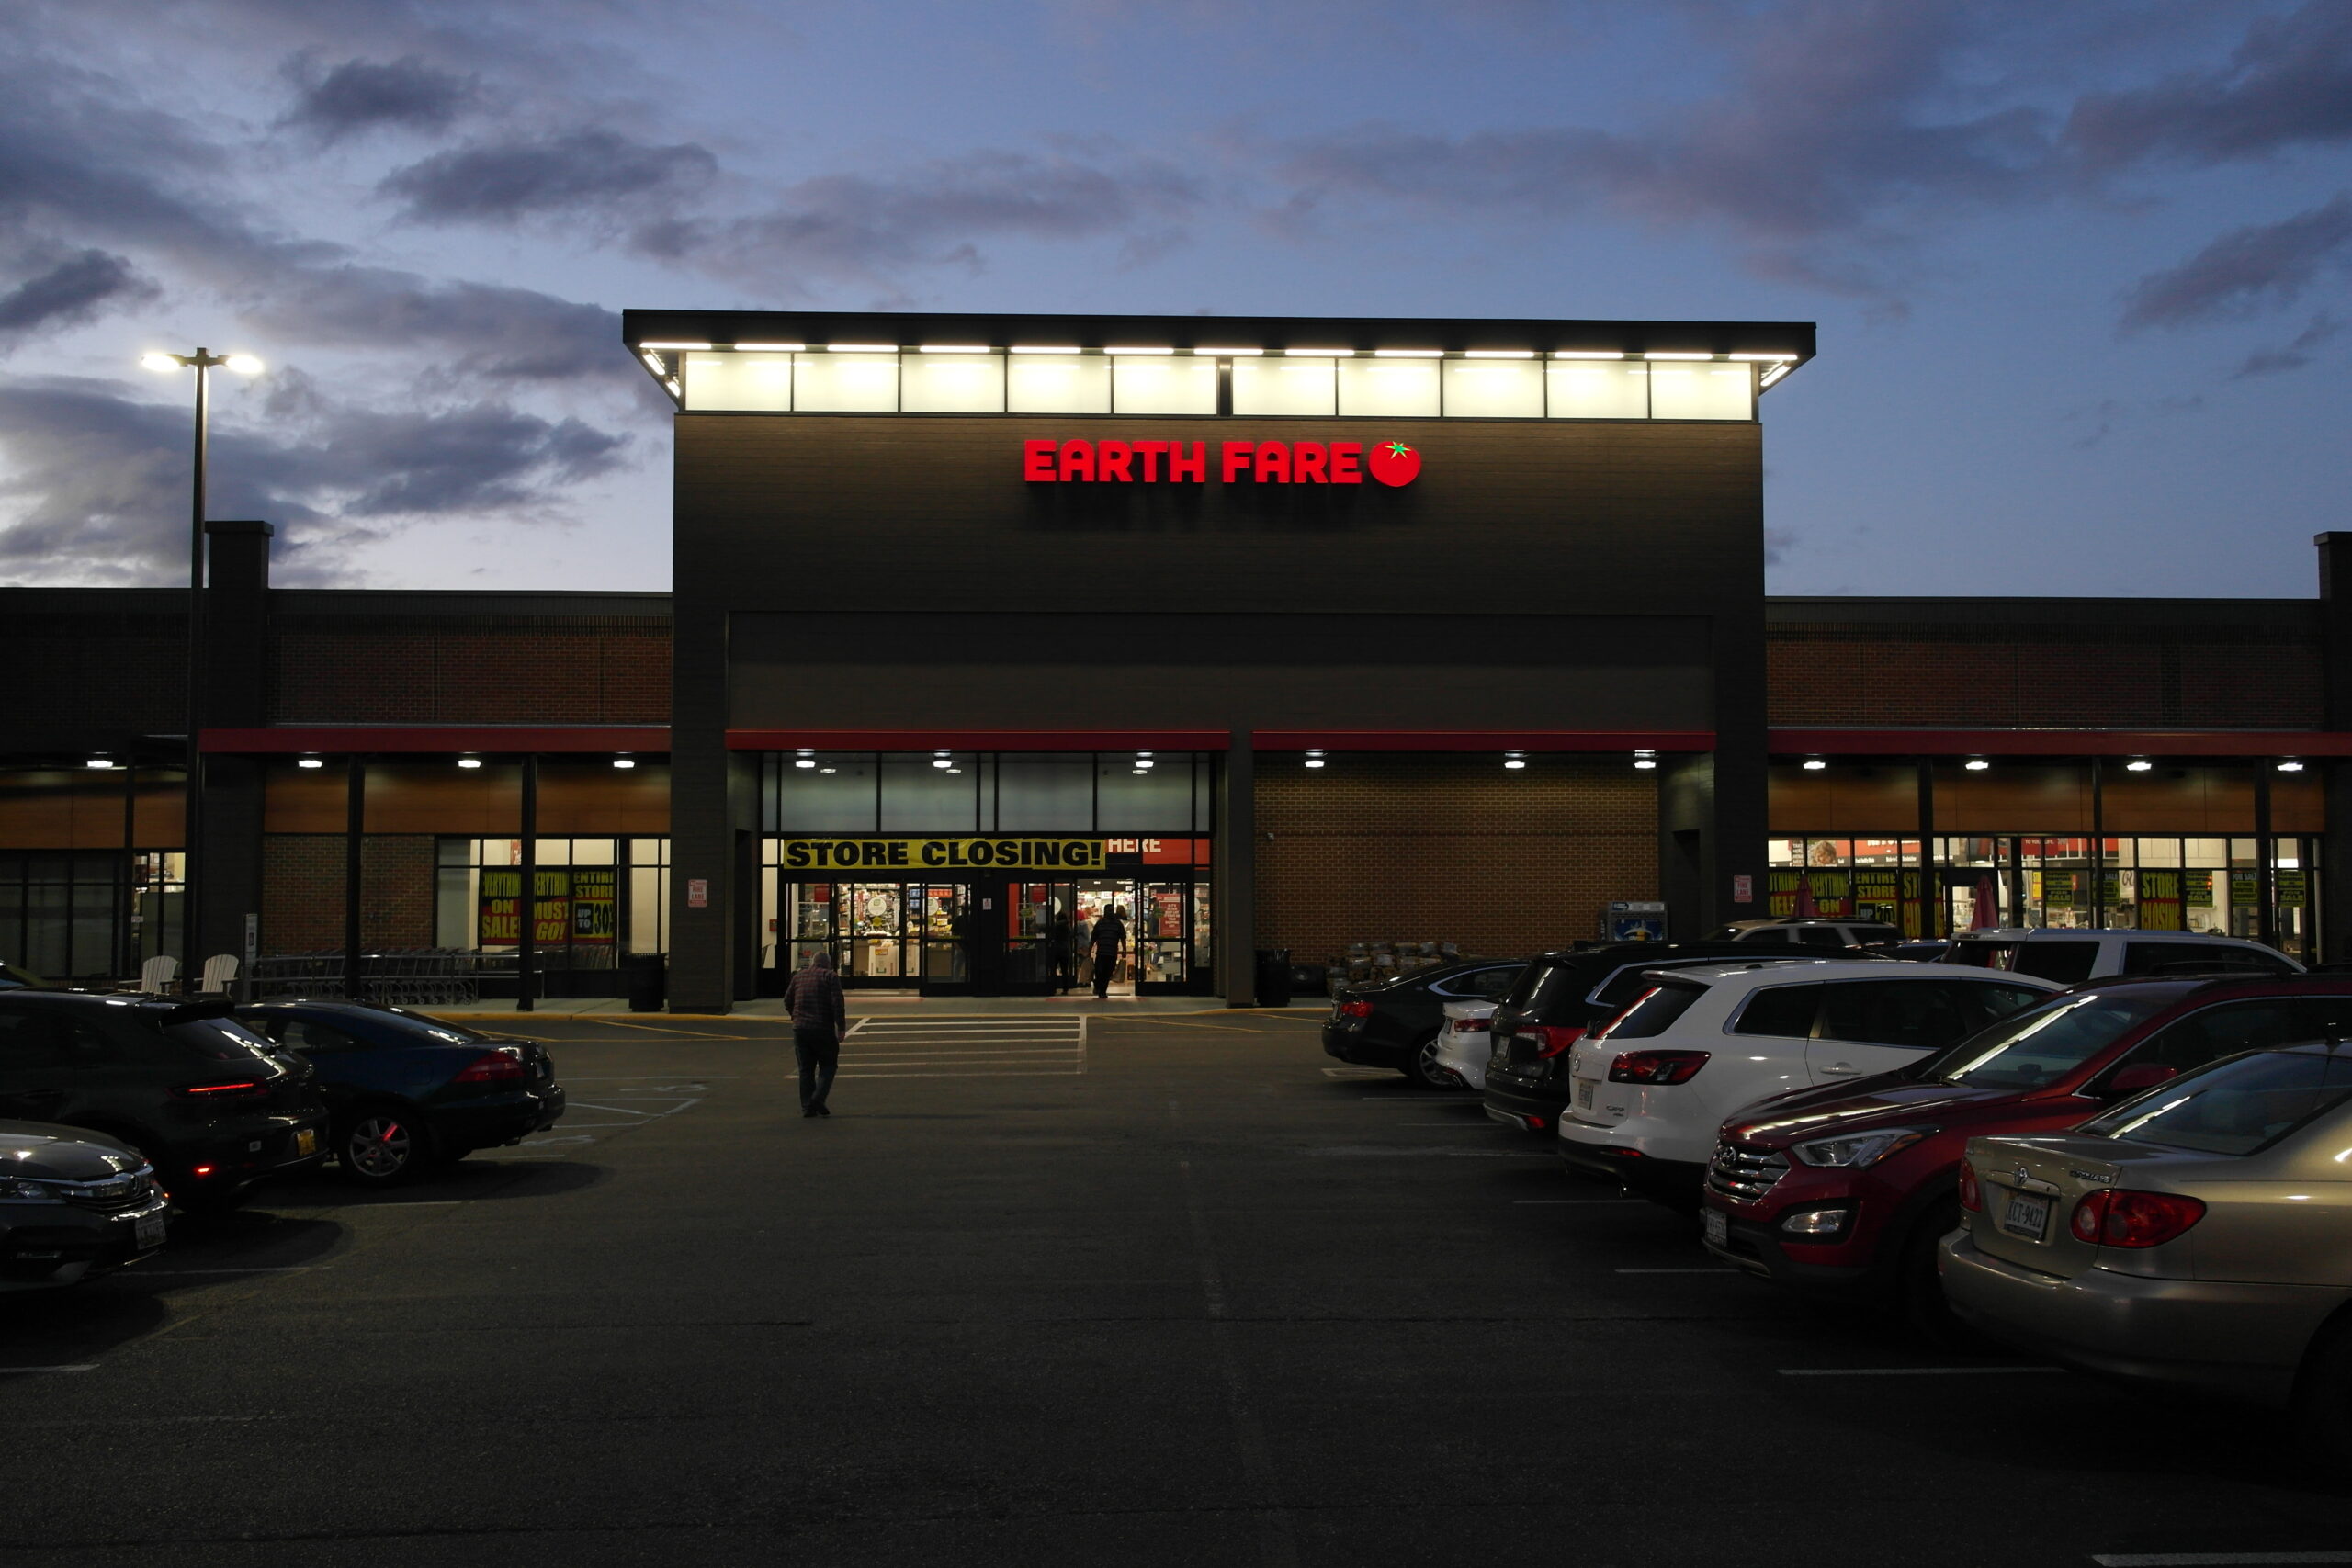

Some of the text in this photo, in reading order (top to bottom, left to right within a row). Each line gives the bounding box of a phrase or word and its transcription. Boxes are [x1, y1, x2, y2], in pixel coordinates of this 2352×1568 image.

[1024, 439, 1363, 484] EARTH FARE
[1108, 838, 1162, 852] HERE
[786, 840, 1102, 867] STORE CLOSING!
[482, 872, 522, 897] VERYTHIN
[1855, 872, 1896, 884] ENTIRE
[2142, 872, 2180, 899] STORE
[1858, 885, 1896, 898] STORE
[491, 899, 514, 914] ON
[577, 908, 591, 918] UP
[1819, 899, 1840, 914] ON
[578, 919, 591, 928] TO
[536, 922, 567, 942] GO!
